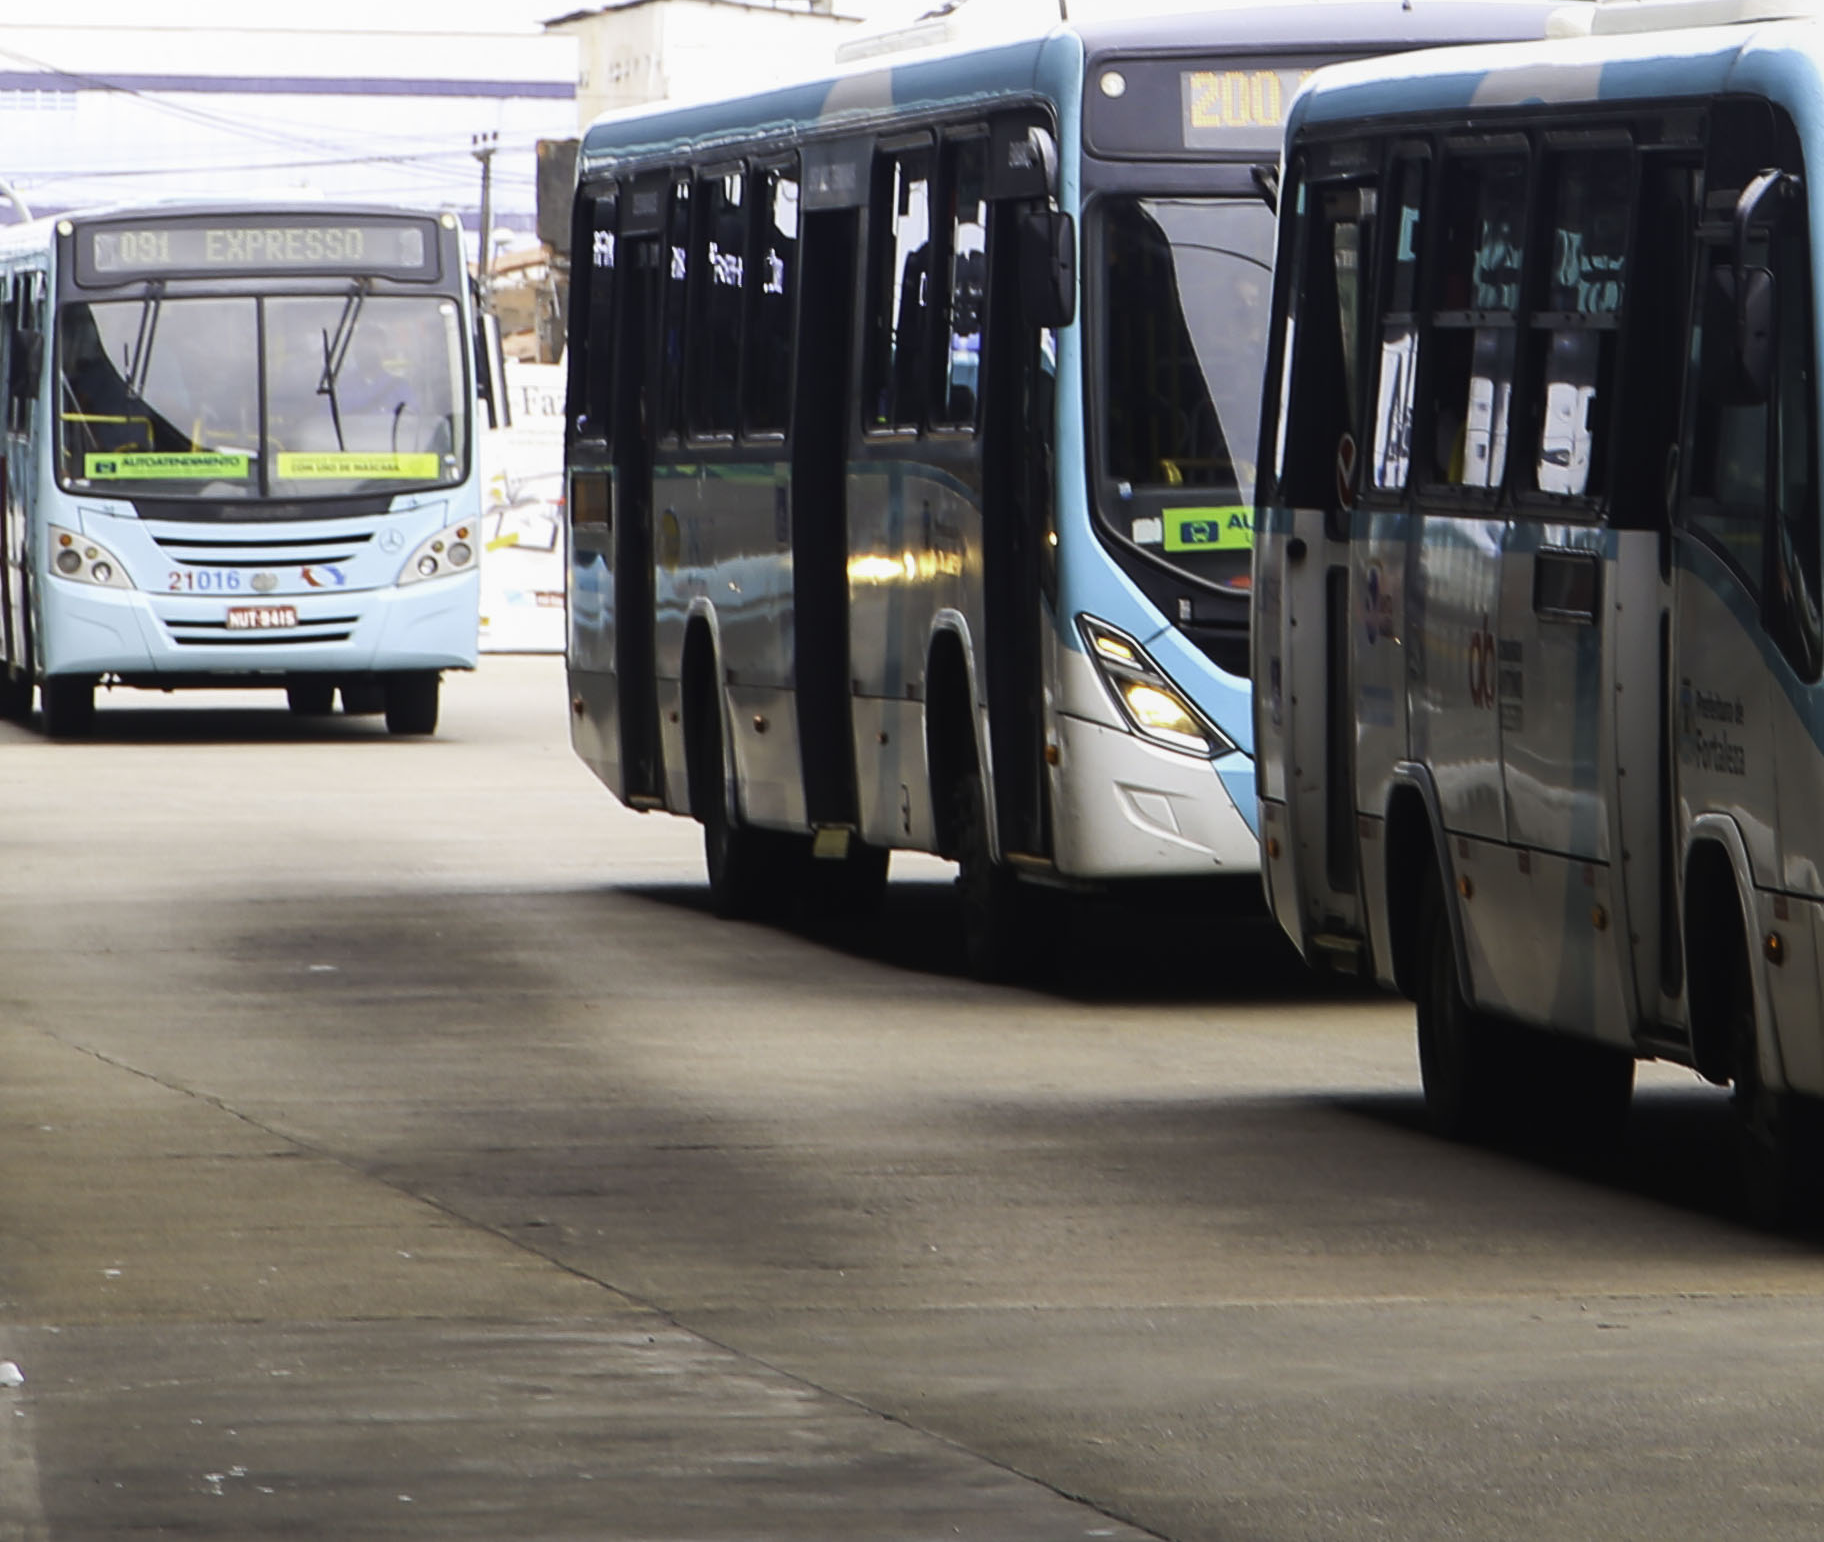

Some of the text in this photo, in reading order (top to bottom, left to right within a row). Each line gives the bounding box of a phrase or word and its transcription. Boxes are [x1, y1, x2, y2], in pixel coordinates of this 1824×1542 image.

[1190, 71, 1282, 128] 200
[120, 229, 364, 263] 091 EXPRESSO
[168, 570, 240, 592] 21016
